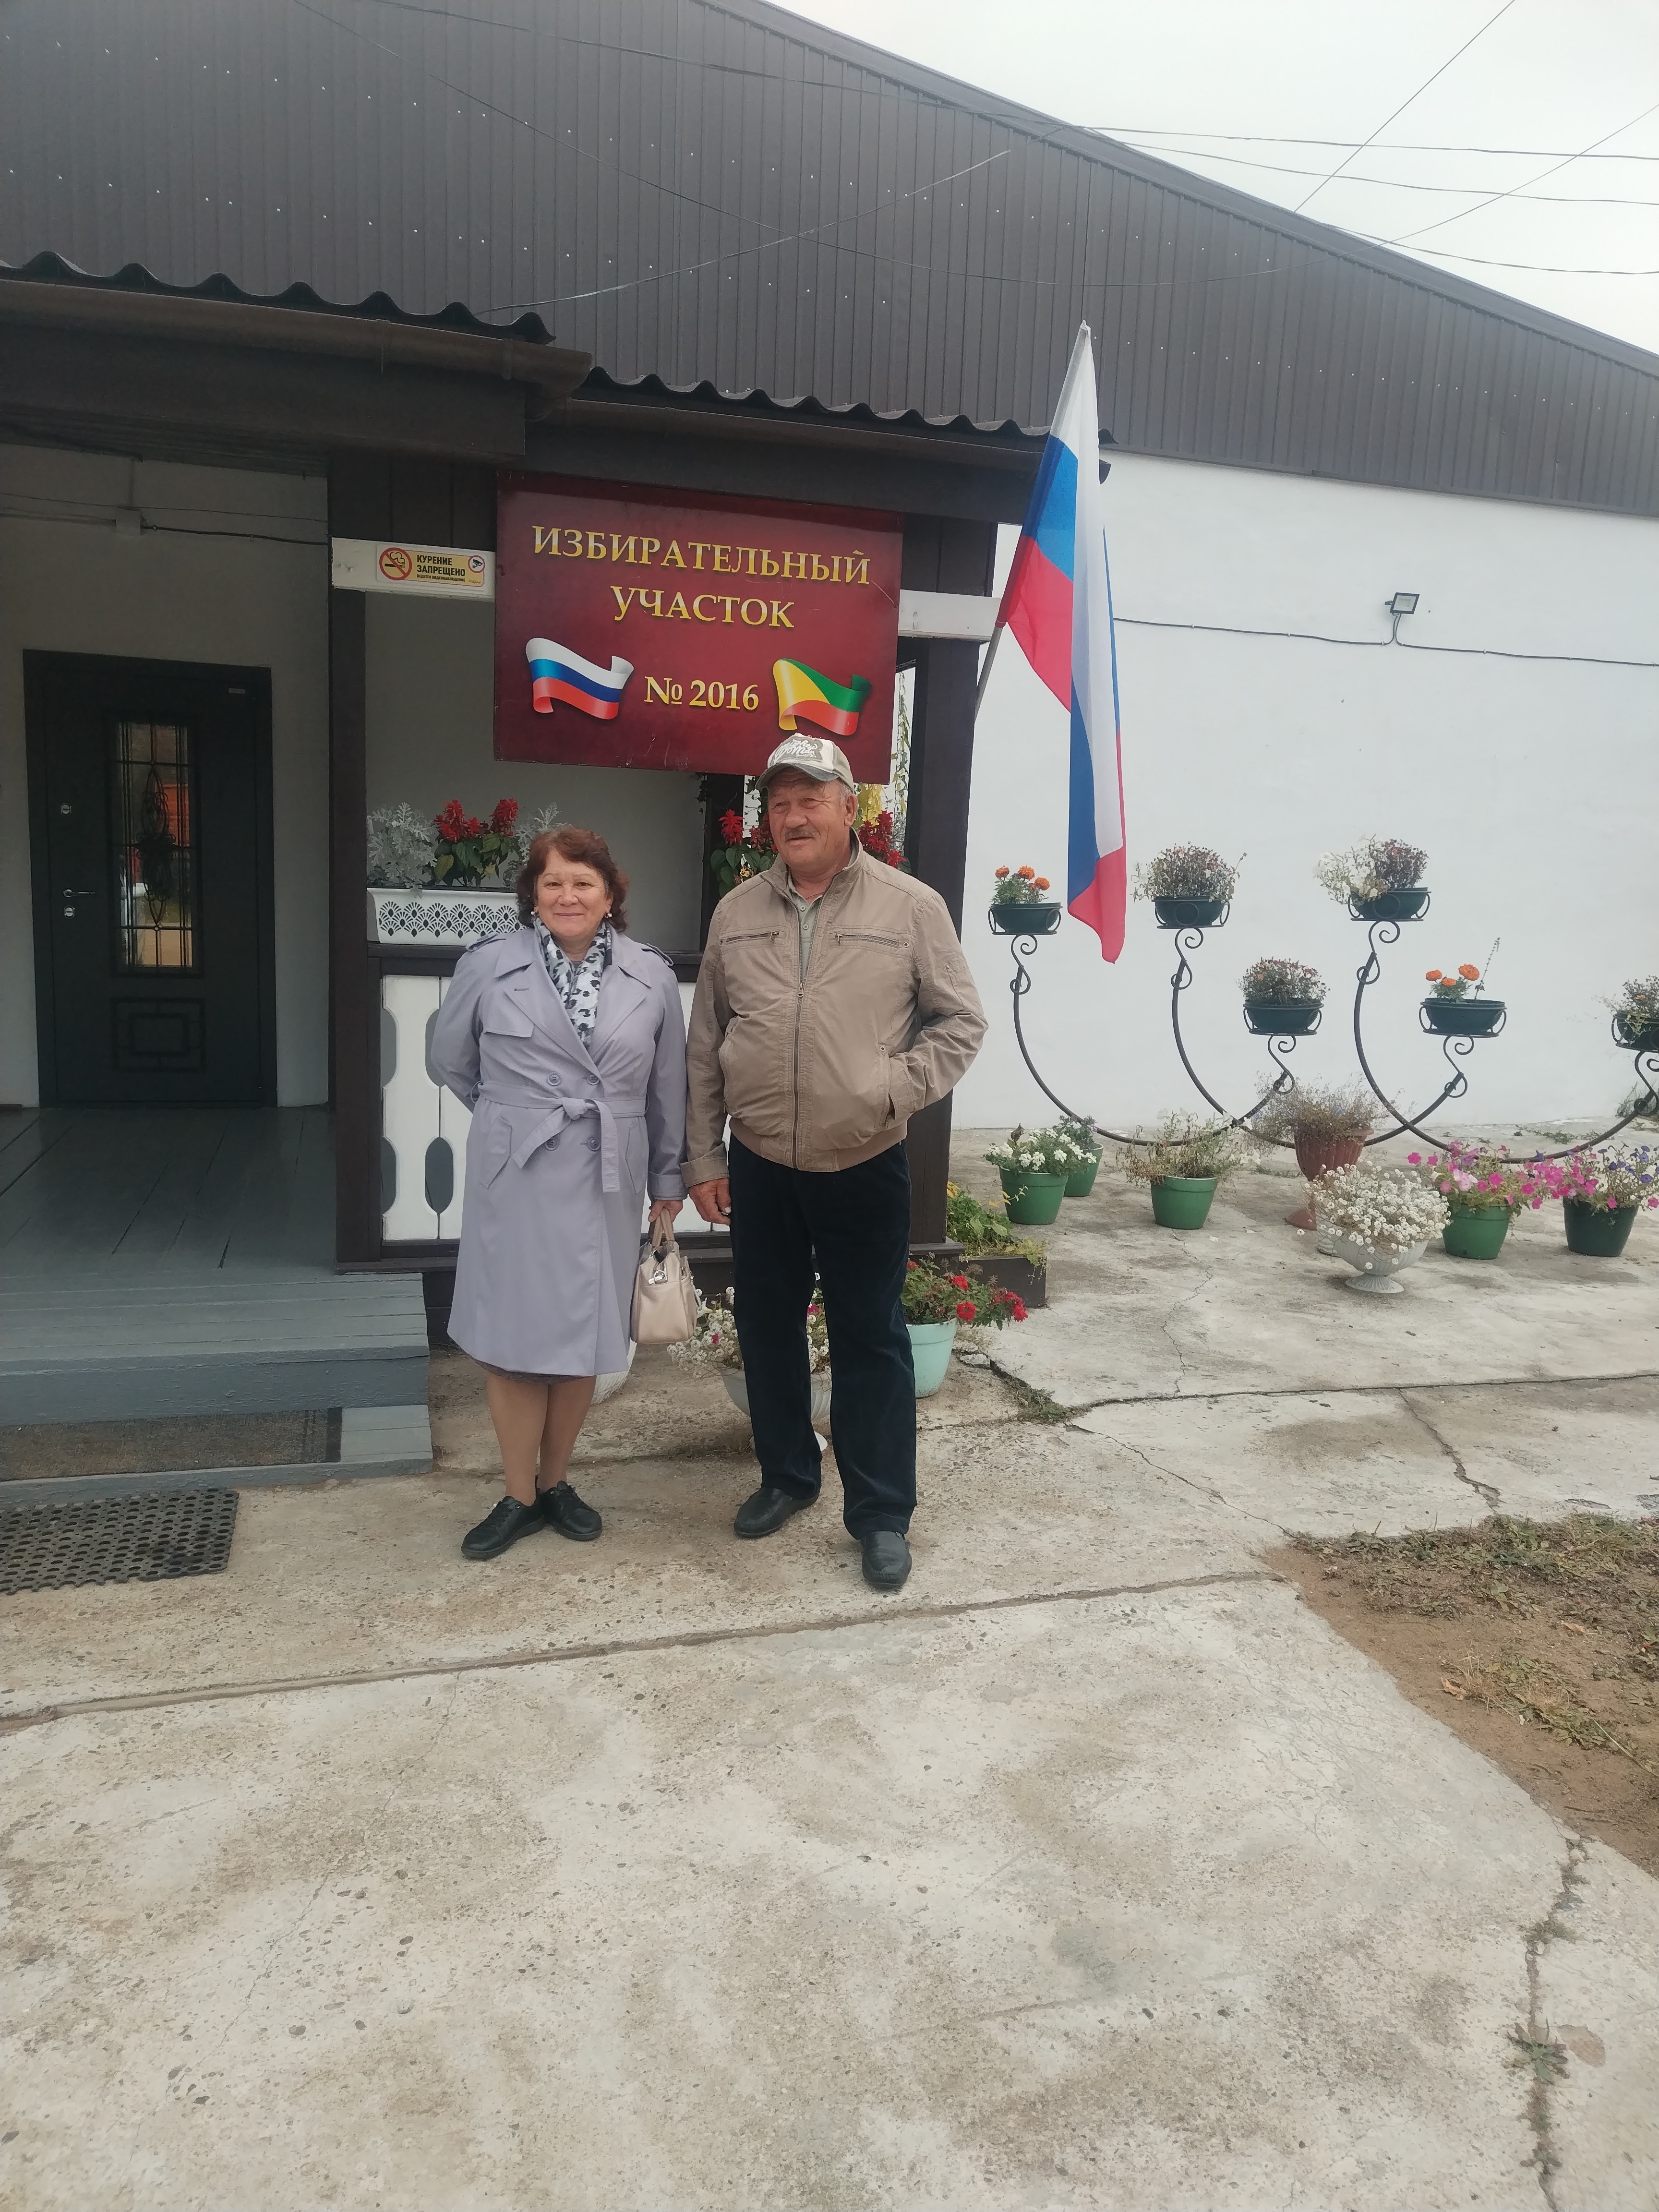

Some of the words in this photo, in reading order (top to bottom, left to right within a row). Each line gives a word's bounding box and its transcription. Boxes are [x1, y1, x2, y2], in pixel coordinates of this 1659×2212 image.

[417, 554, 452, 565] КУРЕНИЕ
[417, 565, 466, 577] ЗАПРЕЩЕНО
[532, 525, 871, 585] ИЗБИРАТЕЛЬНЫЙ
[610, 585, 795, 628] УЧАСТОК
[644, 676, 683, 705] №
[689, 680, 759, 711] 2016
